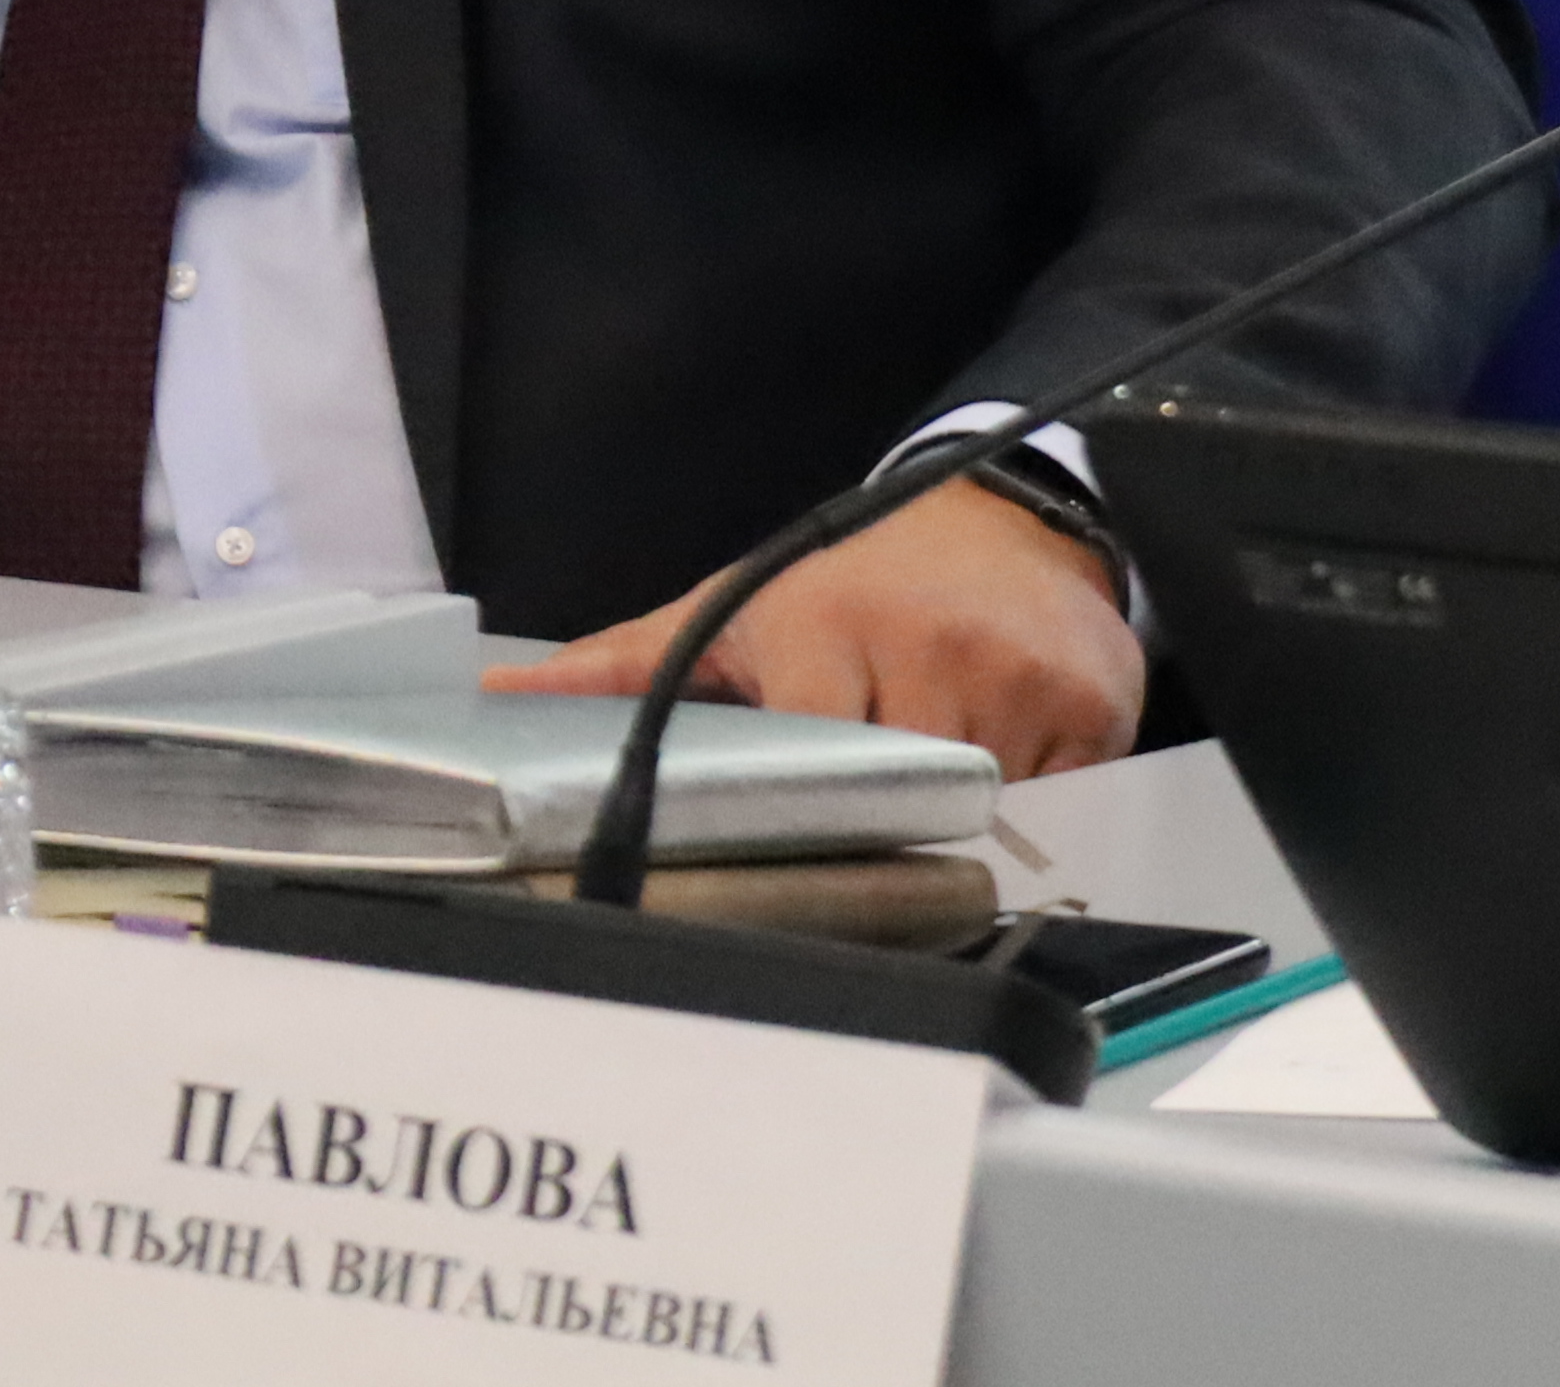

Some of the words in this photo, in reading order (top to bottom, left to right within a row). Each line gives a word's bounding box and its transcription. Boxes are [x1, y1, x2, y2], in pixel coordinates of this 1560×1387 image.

[168, 1080, 641, 1234] ПАВЛОВА
[5, 1185, 305, 1290] ТАТЬЯНА
[327, 1238, 776, 1366] ВИТАЛЬЕВНА
